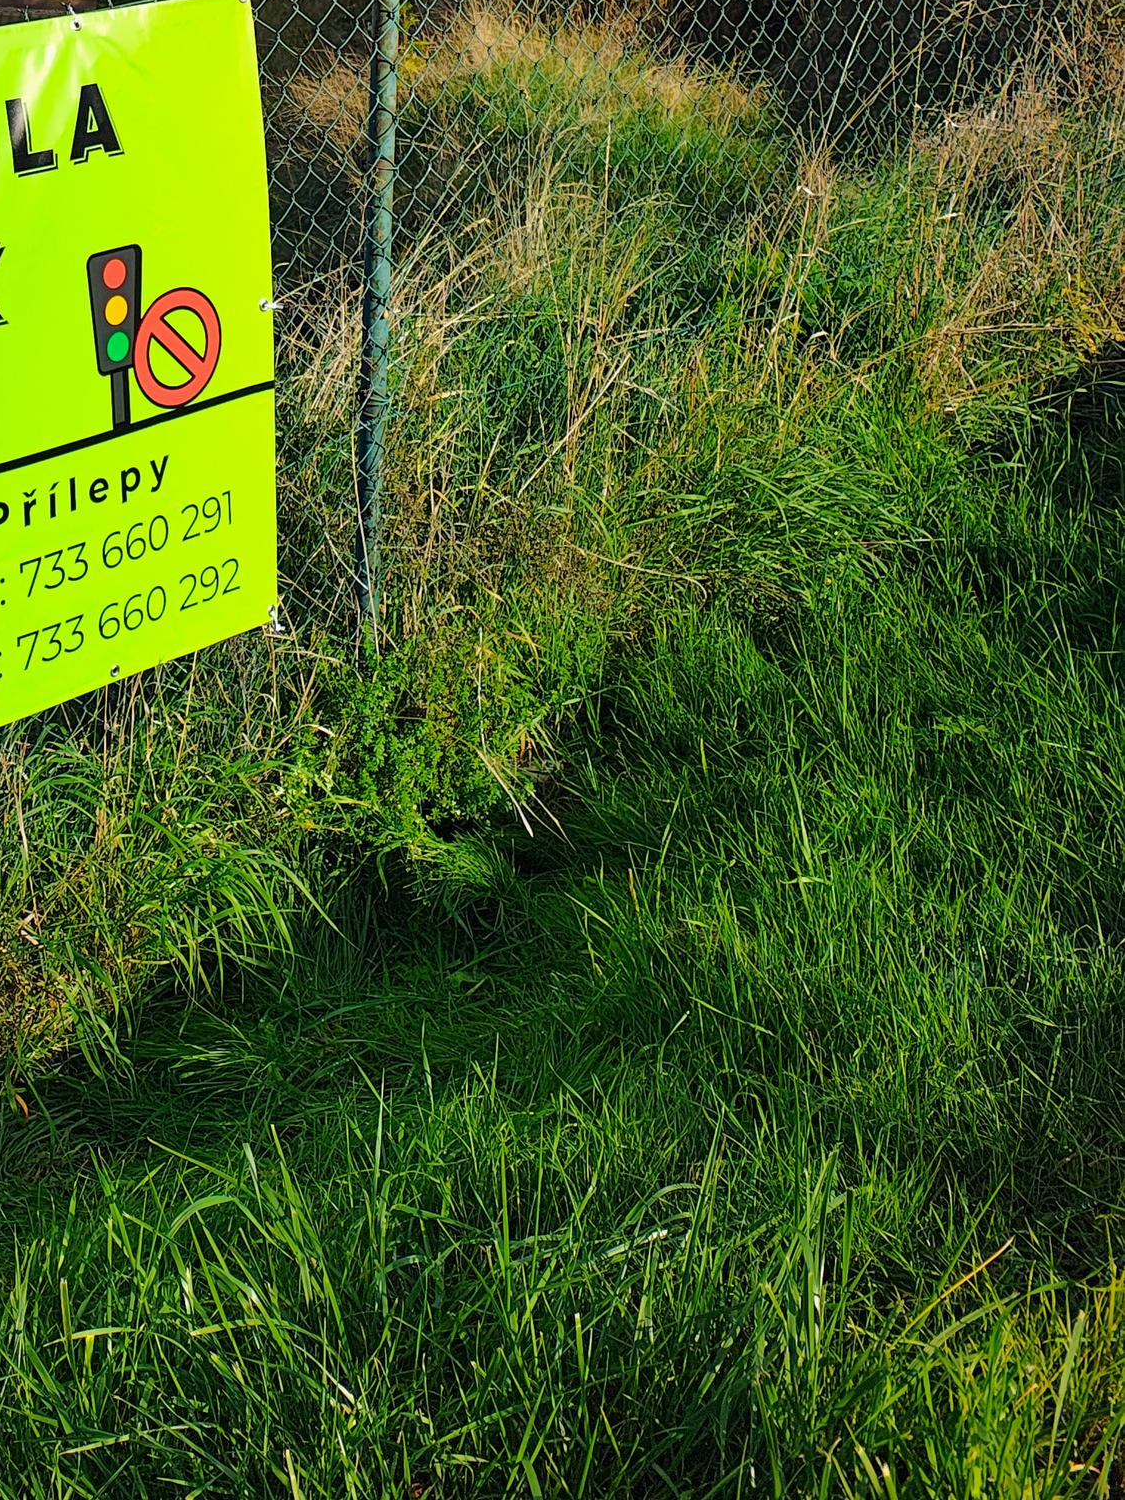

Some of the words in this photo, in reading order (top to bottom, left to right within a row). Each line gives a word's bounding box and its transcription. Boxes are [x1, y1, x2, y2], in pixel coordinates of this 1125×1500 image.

[19, 541, 89, 599] 733
[101, 514, 169, 569] 660
[181, 489, 233, 543] 291
[16, 613, 84, 671] 733
[98, 585, 167, 640] 660
[179, 557, 241, 612] 292
